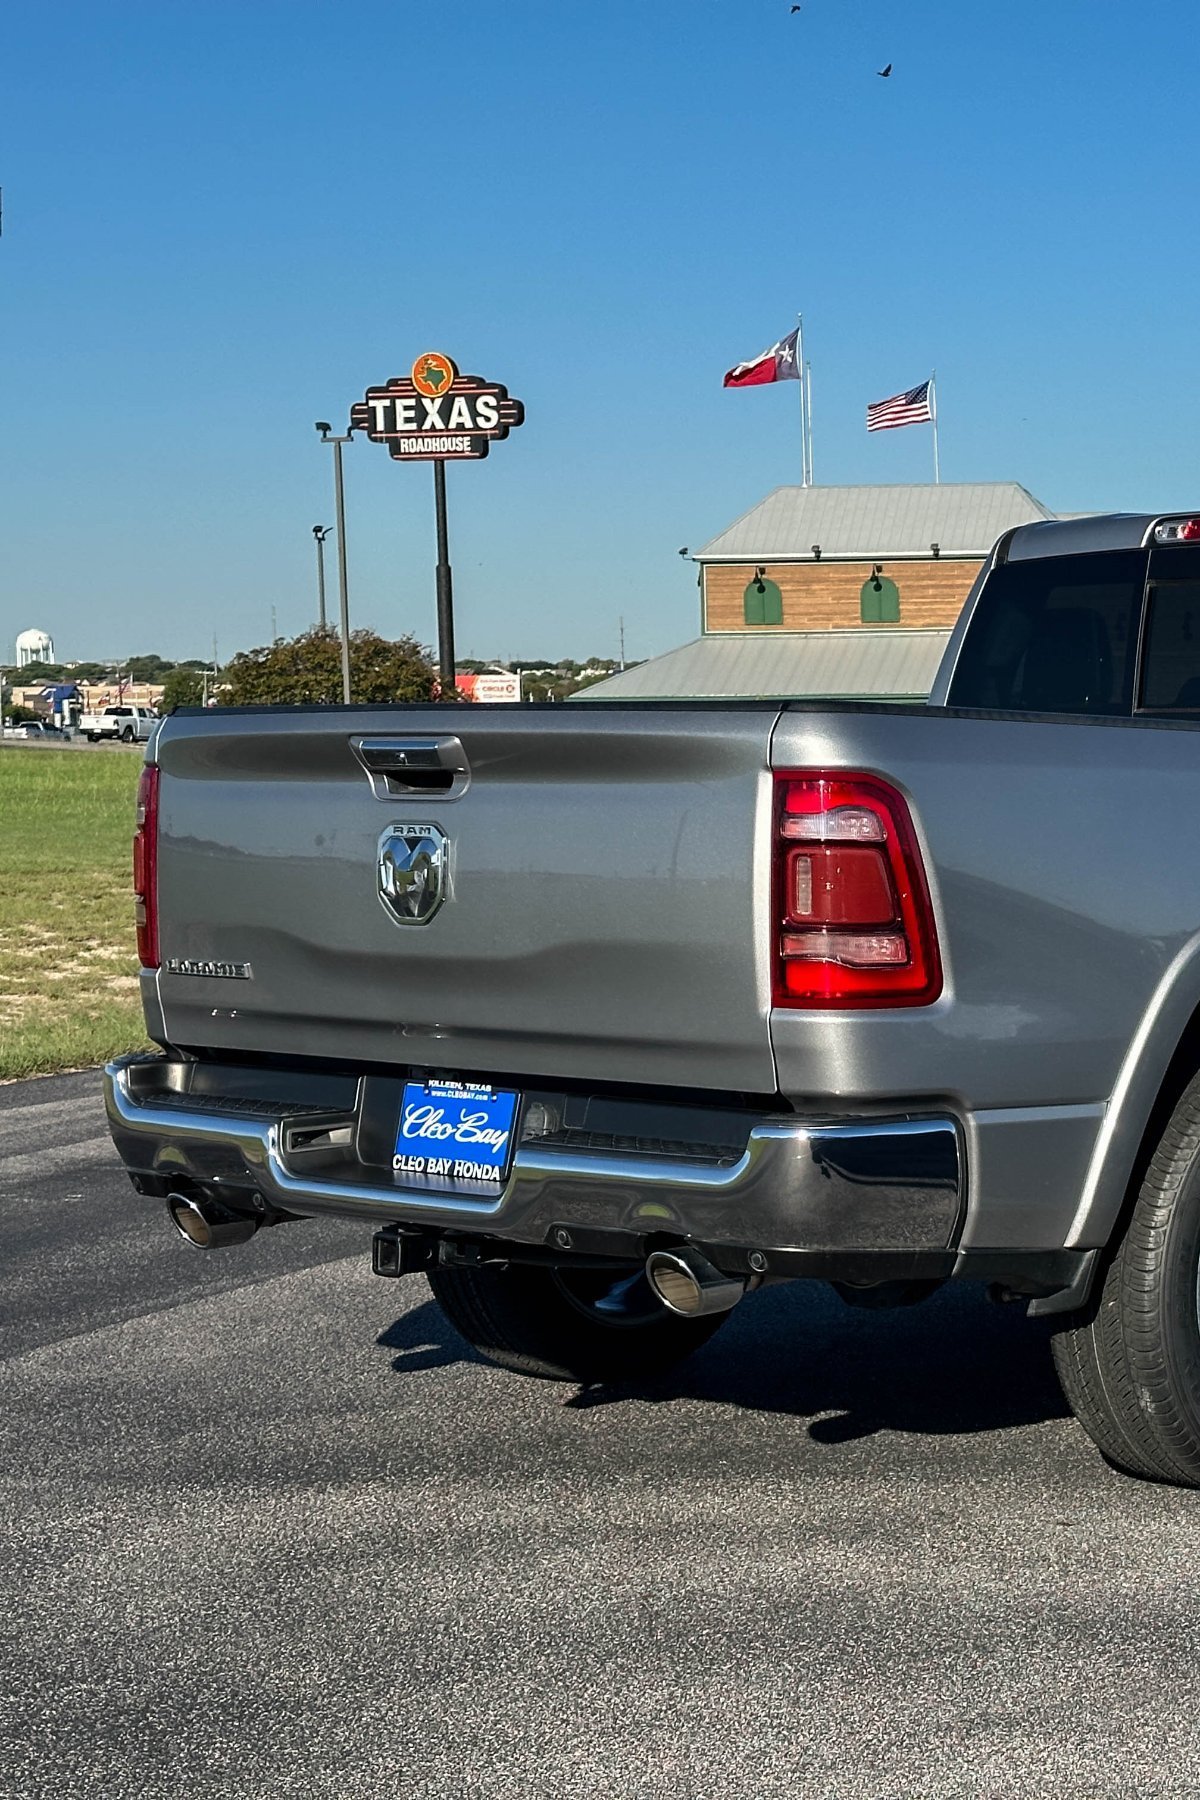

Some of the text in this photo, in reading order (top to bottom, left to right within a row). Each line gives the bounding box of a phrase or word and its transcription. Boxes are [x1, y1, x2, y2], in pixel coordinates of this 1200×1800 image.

[368, 395, 499, 431] TEXAS
[400, 436, 471, 453] ROADHOUSE
[392, 826, 432, 836] RAM
[464, 1083, 492, 1092] TEXAS
[402, 1103, 509, 1154] Cleo Bay
[392, 1154, 500, 1181] CLEO BAY HONDA
